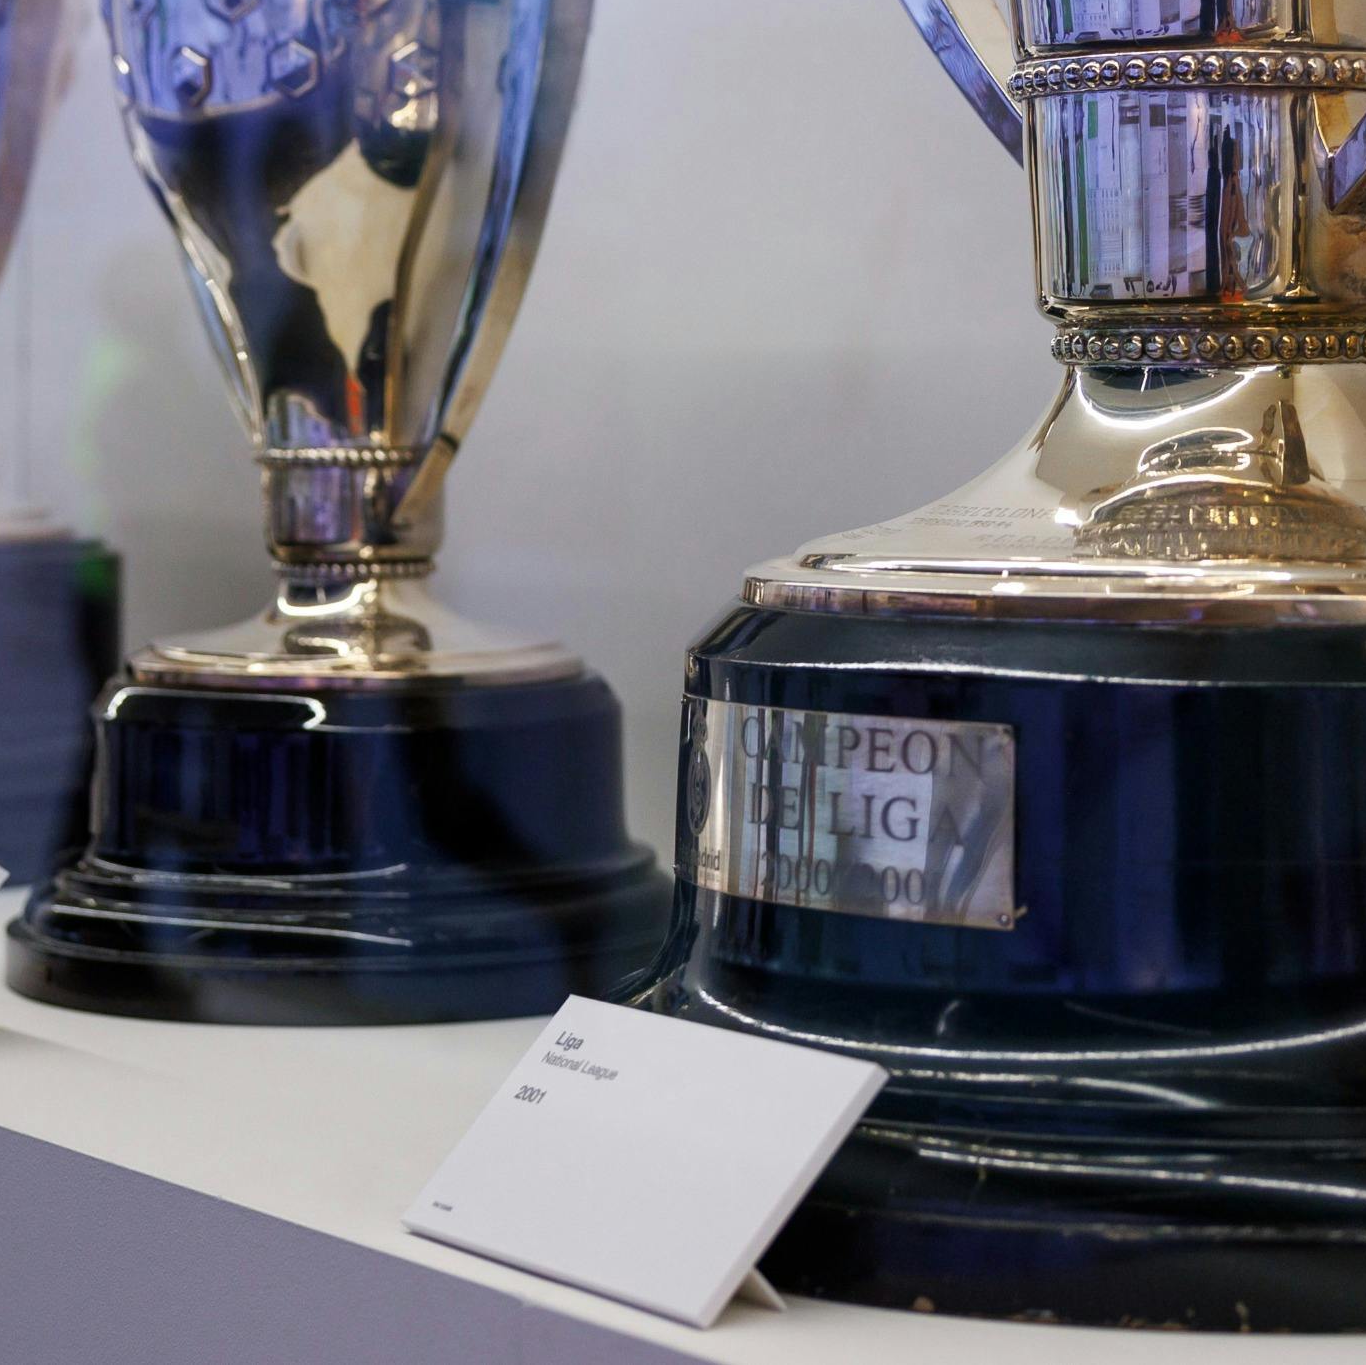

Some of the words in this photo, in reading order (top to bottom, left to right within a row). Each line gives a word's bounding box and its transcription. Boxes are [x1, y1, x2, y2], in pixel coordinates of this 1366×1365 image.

[749, 782, 803, 831] DE
[828, 791, 964, 847] LIGA
[554, 1030, 584, 1051] Liga
[541, 1051, 584, 1071] National
[580, 1060, 619, 1081] League
[513, 1084, 547, 1104] 2001
